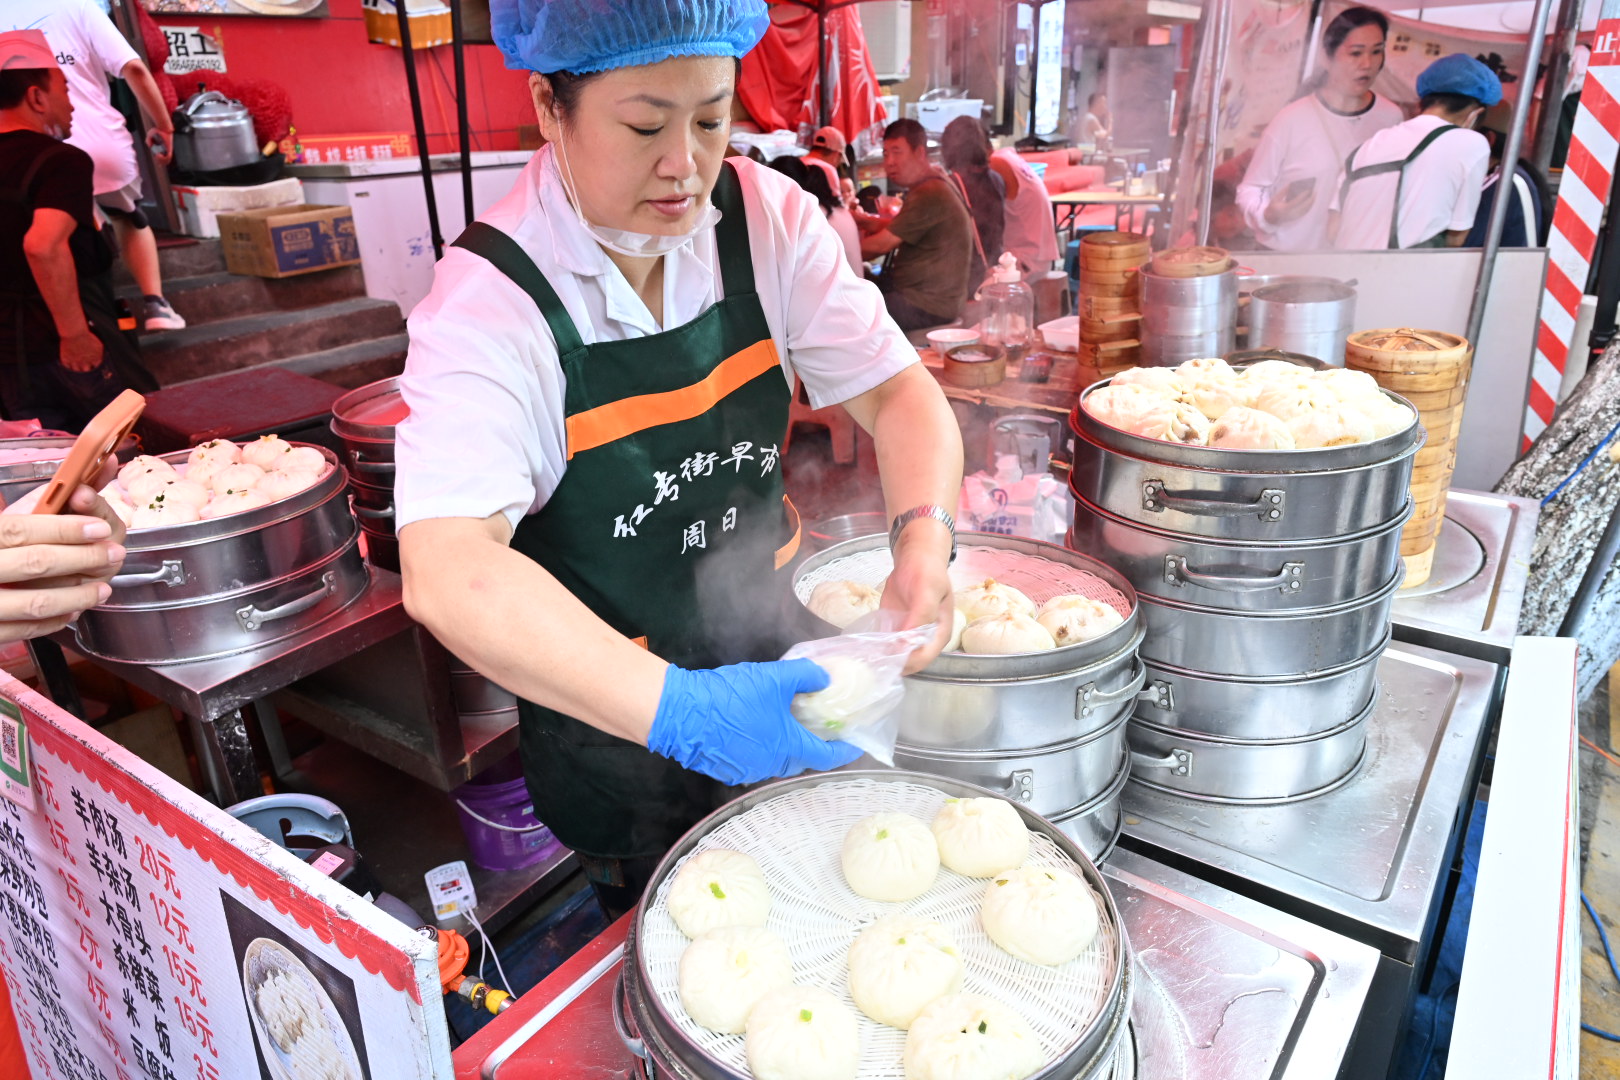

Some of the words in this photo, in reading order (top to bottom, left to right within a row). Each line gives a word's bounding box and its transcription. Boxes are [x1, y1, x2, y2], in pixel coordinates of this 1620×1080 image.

[164, 31, 218, 57] 招工
[681, 507, 737, 554] 周日
[45, 814, 77, 866] 3元
[71, 786, 128, 860] 羊肉汤
[134, 835, 182, 900] 20元
[58, 867, 91, 918] 2元
[85, 838, 141, 912] 羊杂汤
[149, 891, 195, 954] 12元
[74, 918, 103, 970] 2元
[99, 889, 155, 963] 大骨头
[162, 944, 207, 1007] 15元
[87, 970, 112, 1021] 4元
[112, 938, 166, 1014] 杀猪菜
[174, 996, 219, 1059] 15元
[16, 1002, 42, 1048] 5元
[98, 1019, 127, 1066] 4元
